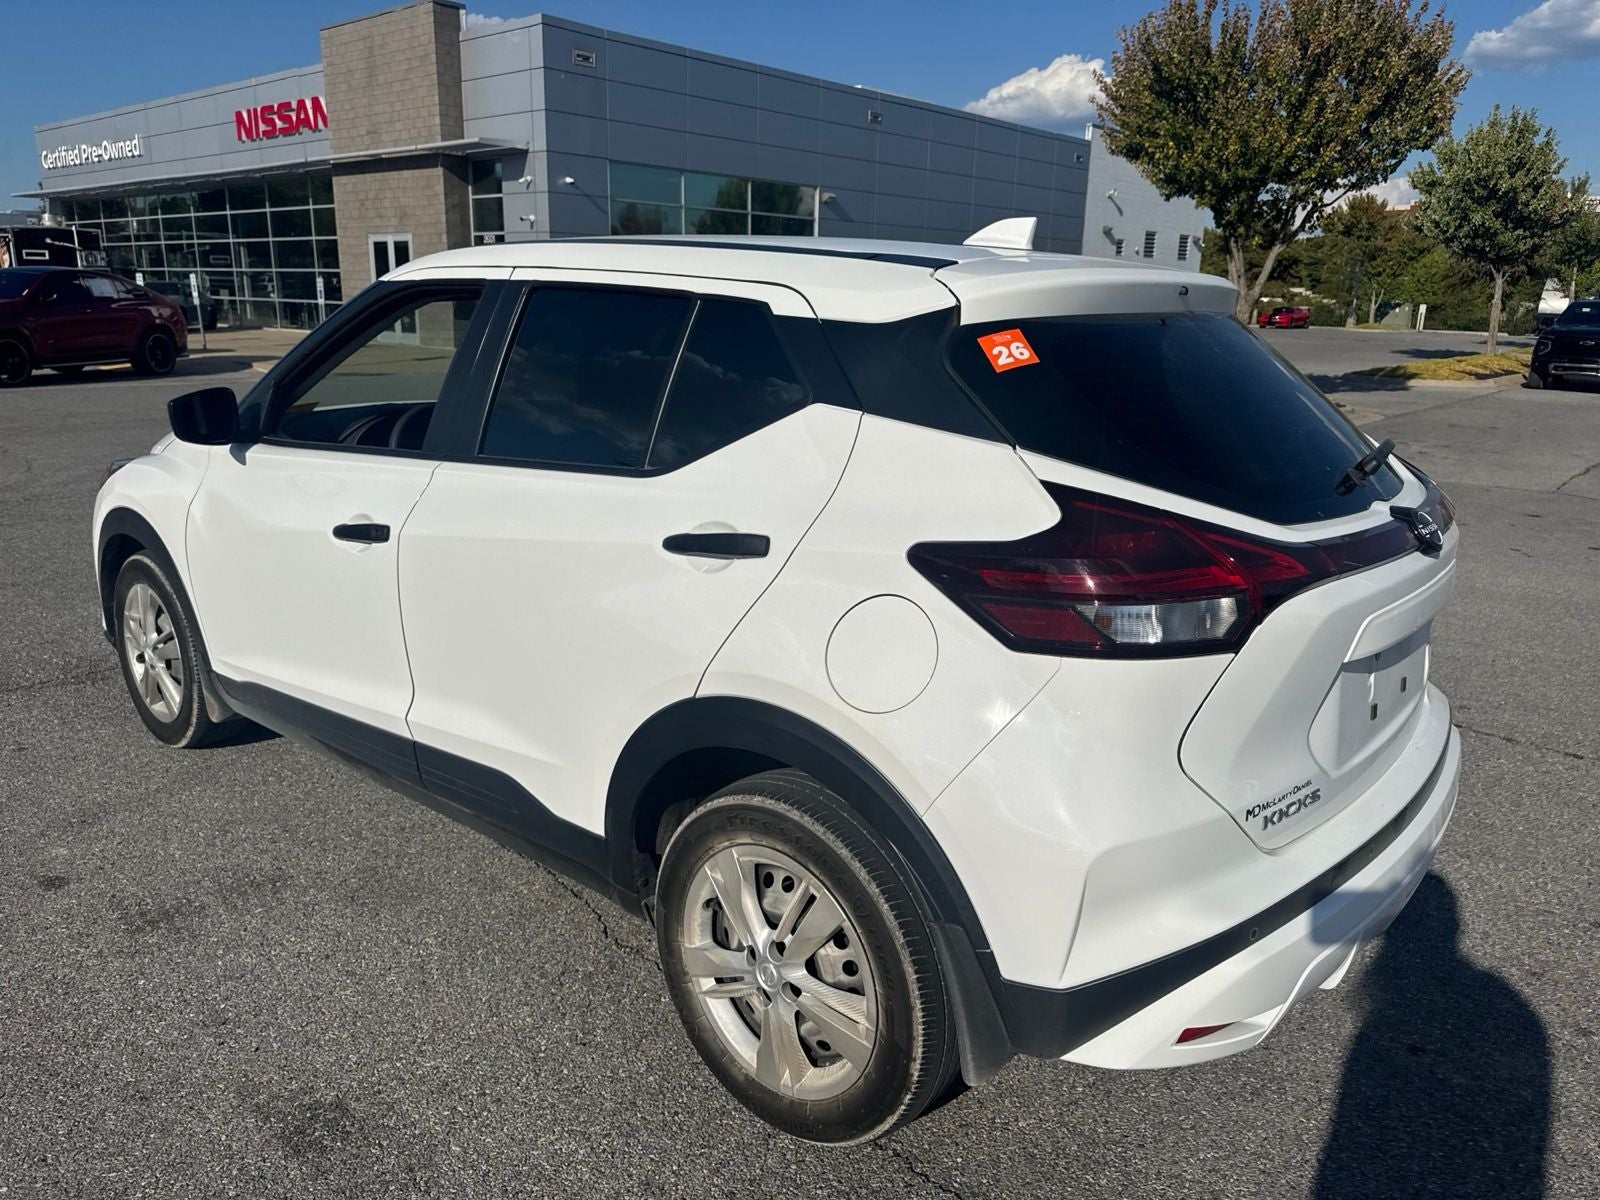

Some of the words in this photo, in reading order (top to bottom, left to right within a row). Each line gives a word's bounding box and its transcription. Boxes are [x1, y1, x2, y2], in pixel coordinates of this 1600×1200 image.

[235, 96, 328, 142] NISSAN
[41, 145, 80, 169] Certified
[81, 134, 140, 162] Pre-Owned
[992, 341, 1031, 366] 26
[1262, 788, 1321, 831] KICKS
